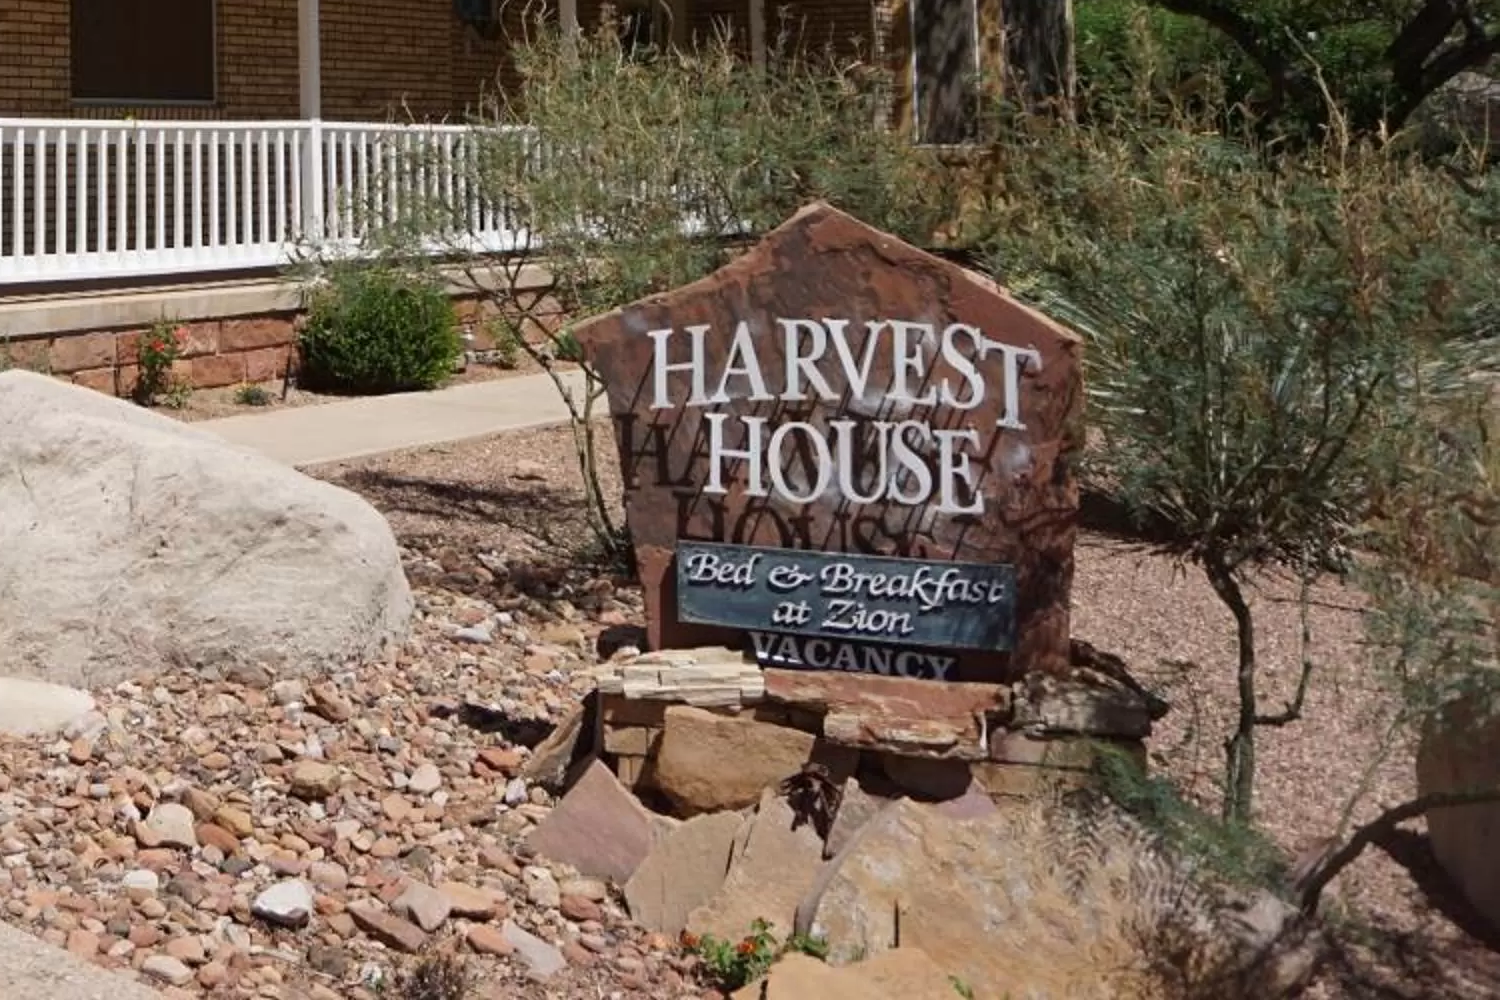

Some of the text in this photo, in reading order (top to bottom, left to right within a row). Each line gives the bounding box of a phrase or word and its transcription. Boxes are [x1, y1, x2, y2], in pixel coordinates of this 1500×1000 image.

[647, 316, 1041, 431] HARVEST
[703, 412, 985, 515] HOUSE
[687, 553, 1004, 611] Bed & Breakfast
[772, 600, 914, 635] at Zion
[749, 632, 957, 682] VACANCY
